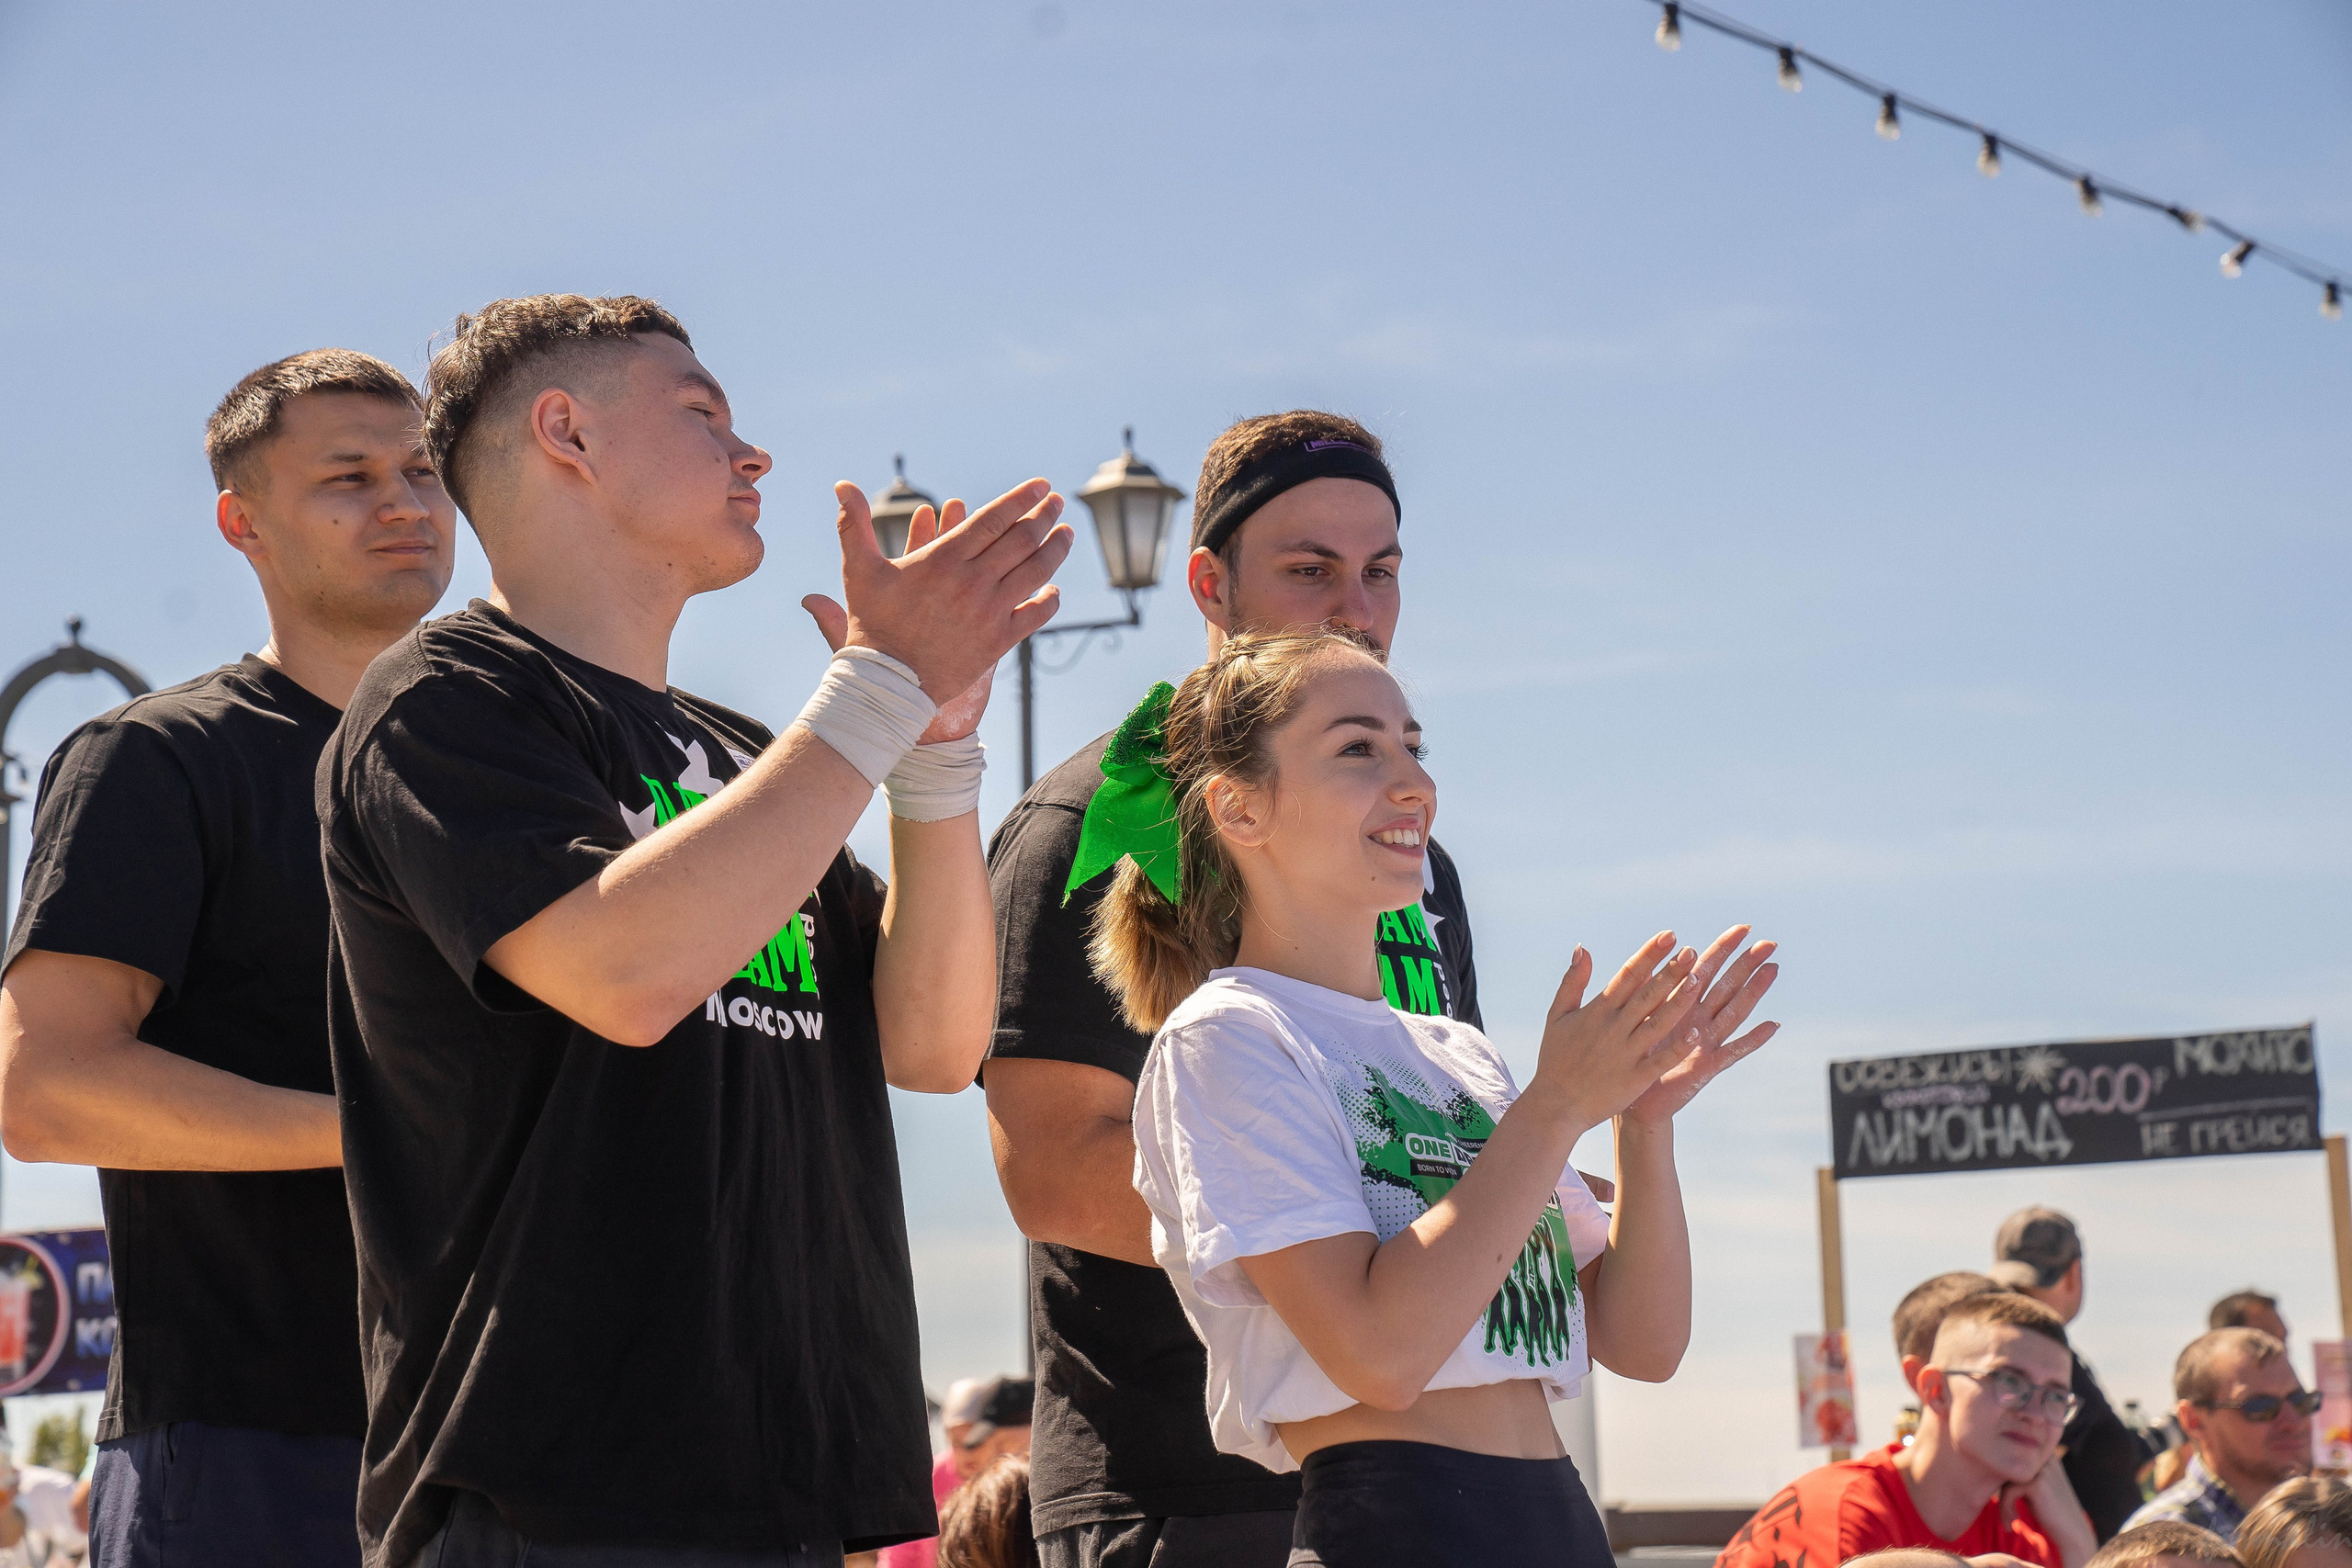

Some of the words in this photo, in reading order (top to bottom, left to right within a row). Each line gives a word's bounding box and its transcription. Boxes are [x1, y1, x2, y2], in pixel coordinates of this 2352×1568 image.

[707, 987, 823, 1041] MOSCOW
[1408, 1135, 1453, 1160] ONE
[1846, 1102, 2074, 1168] ЛИМОНАД
[1417, 1163, 1435, 1173] BORN
[1435, 1166, 1445, 1174] TO
[1444, 1167, 1458, 1176] WIN
